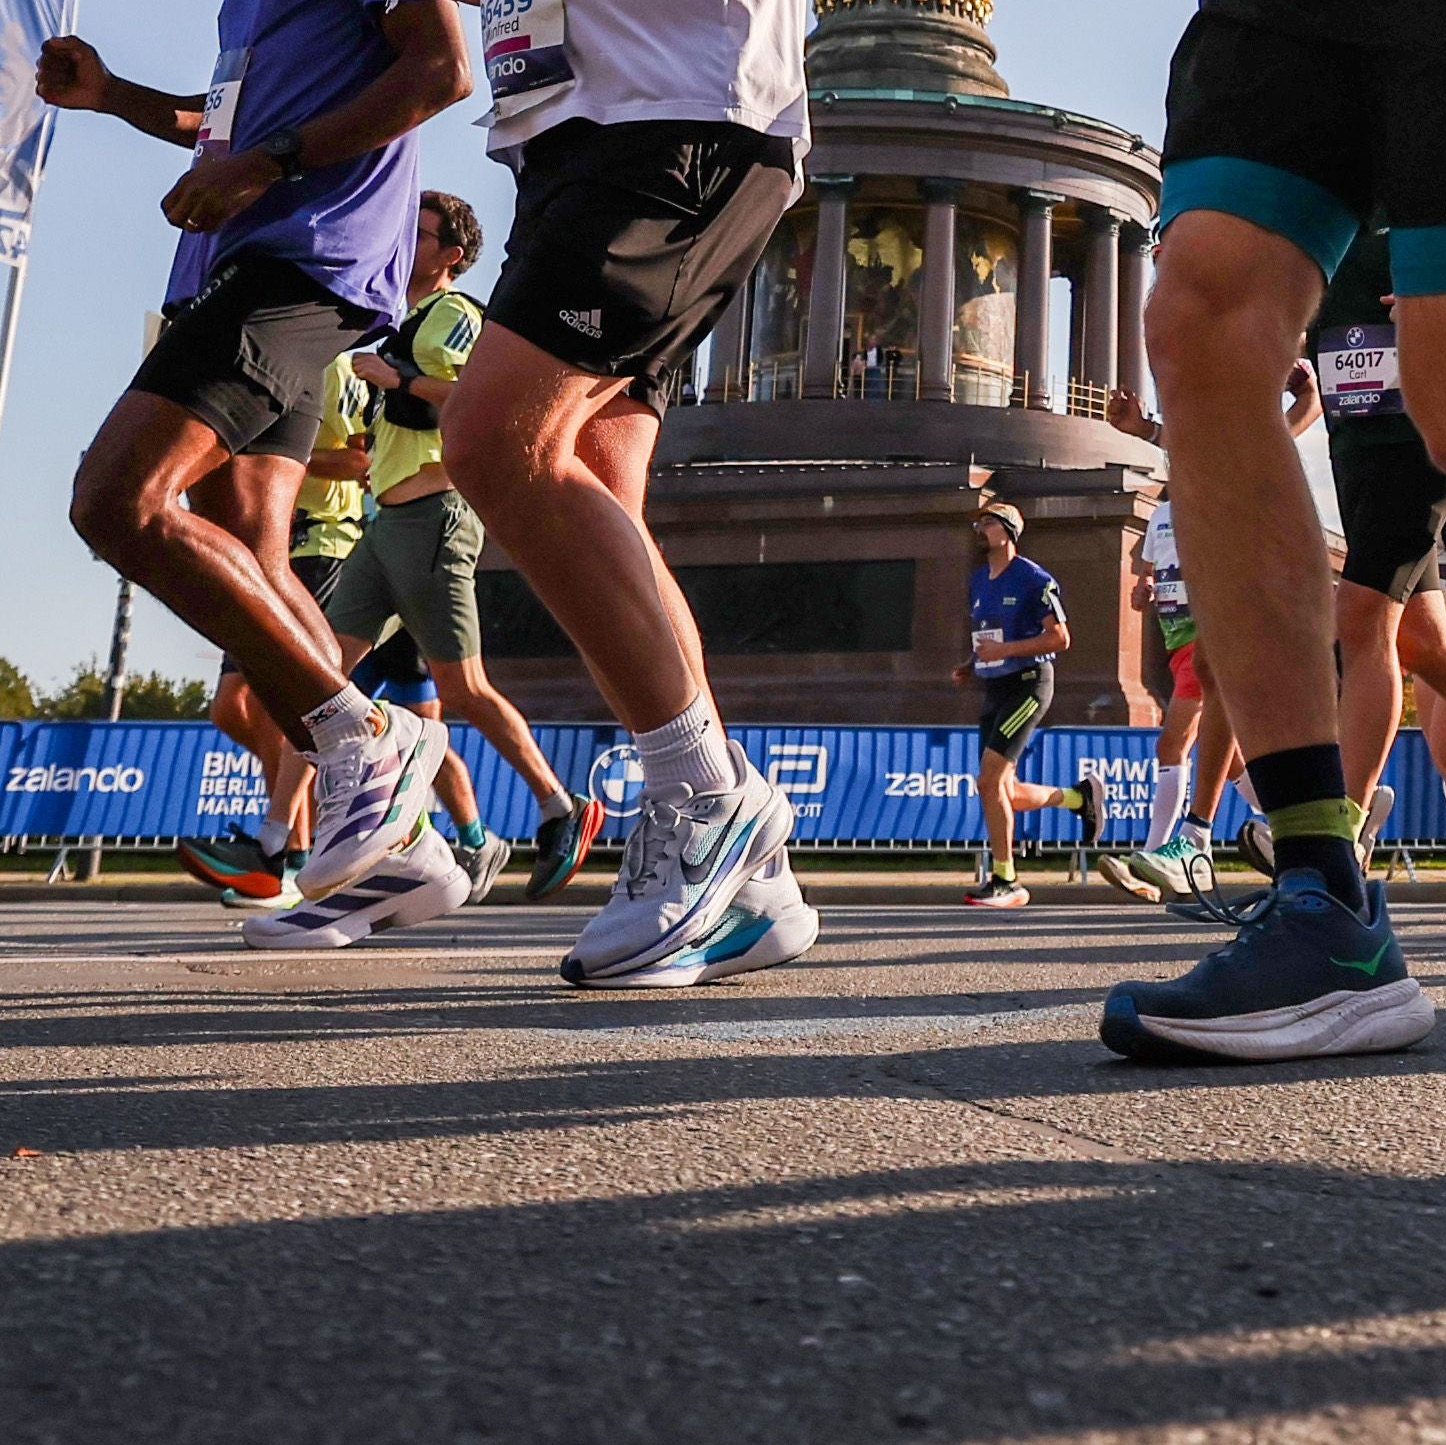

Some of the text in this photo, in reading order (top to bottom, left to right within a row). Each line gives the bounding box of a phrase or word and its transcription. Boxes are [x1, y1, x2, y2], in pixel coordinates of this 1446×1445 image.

[559, 310, 603, 339] adidas
[1335, 351, 1384, 370] 64017
[1349, 369, 1367, 380] Carl
[1338, 391, 1381, 406] zalando
[5, 763, 144, 793] zalando
[1104, 784, 1149, 800] RLIN
